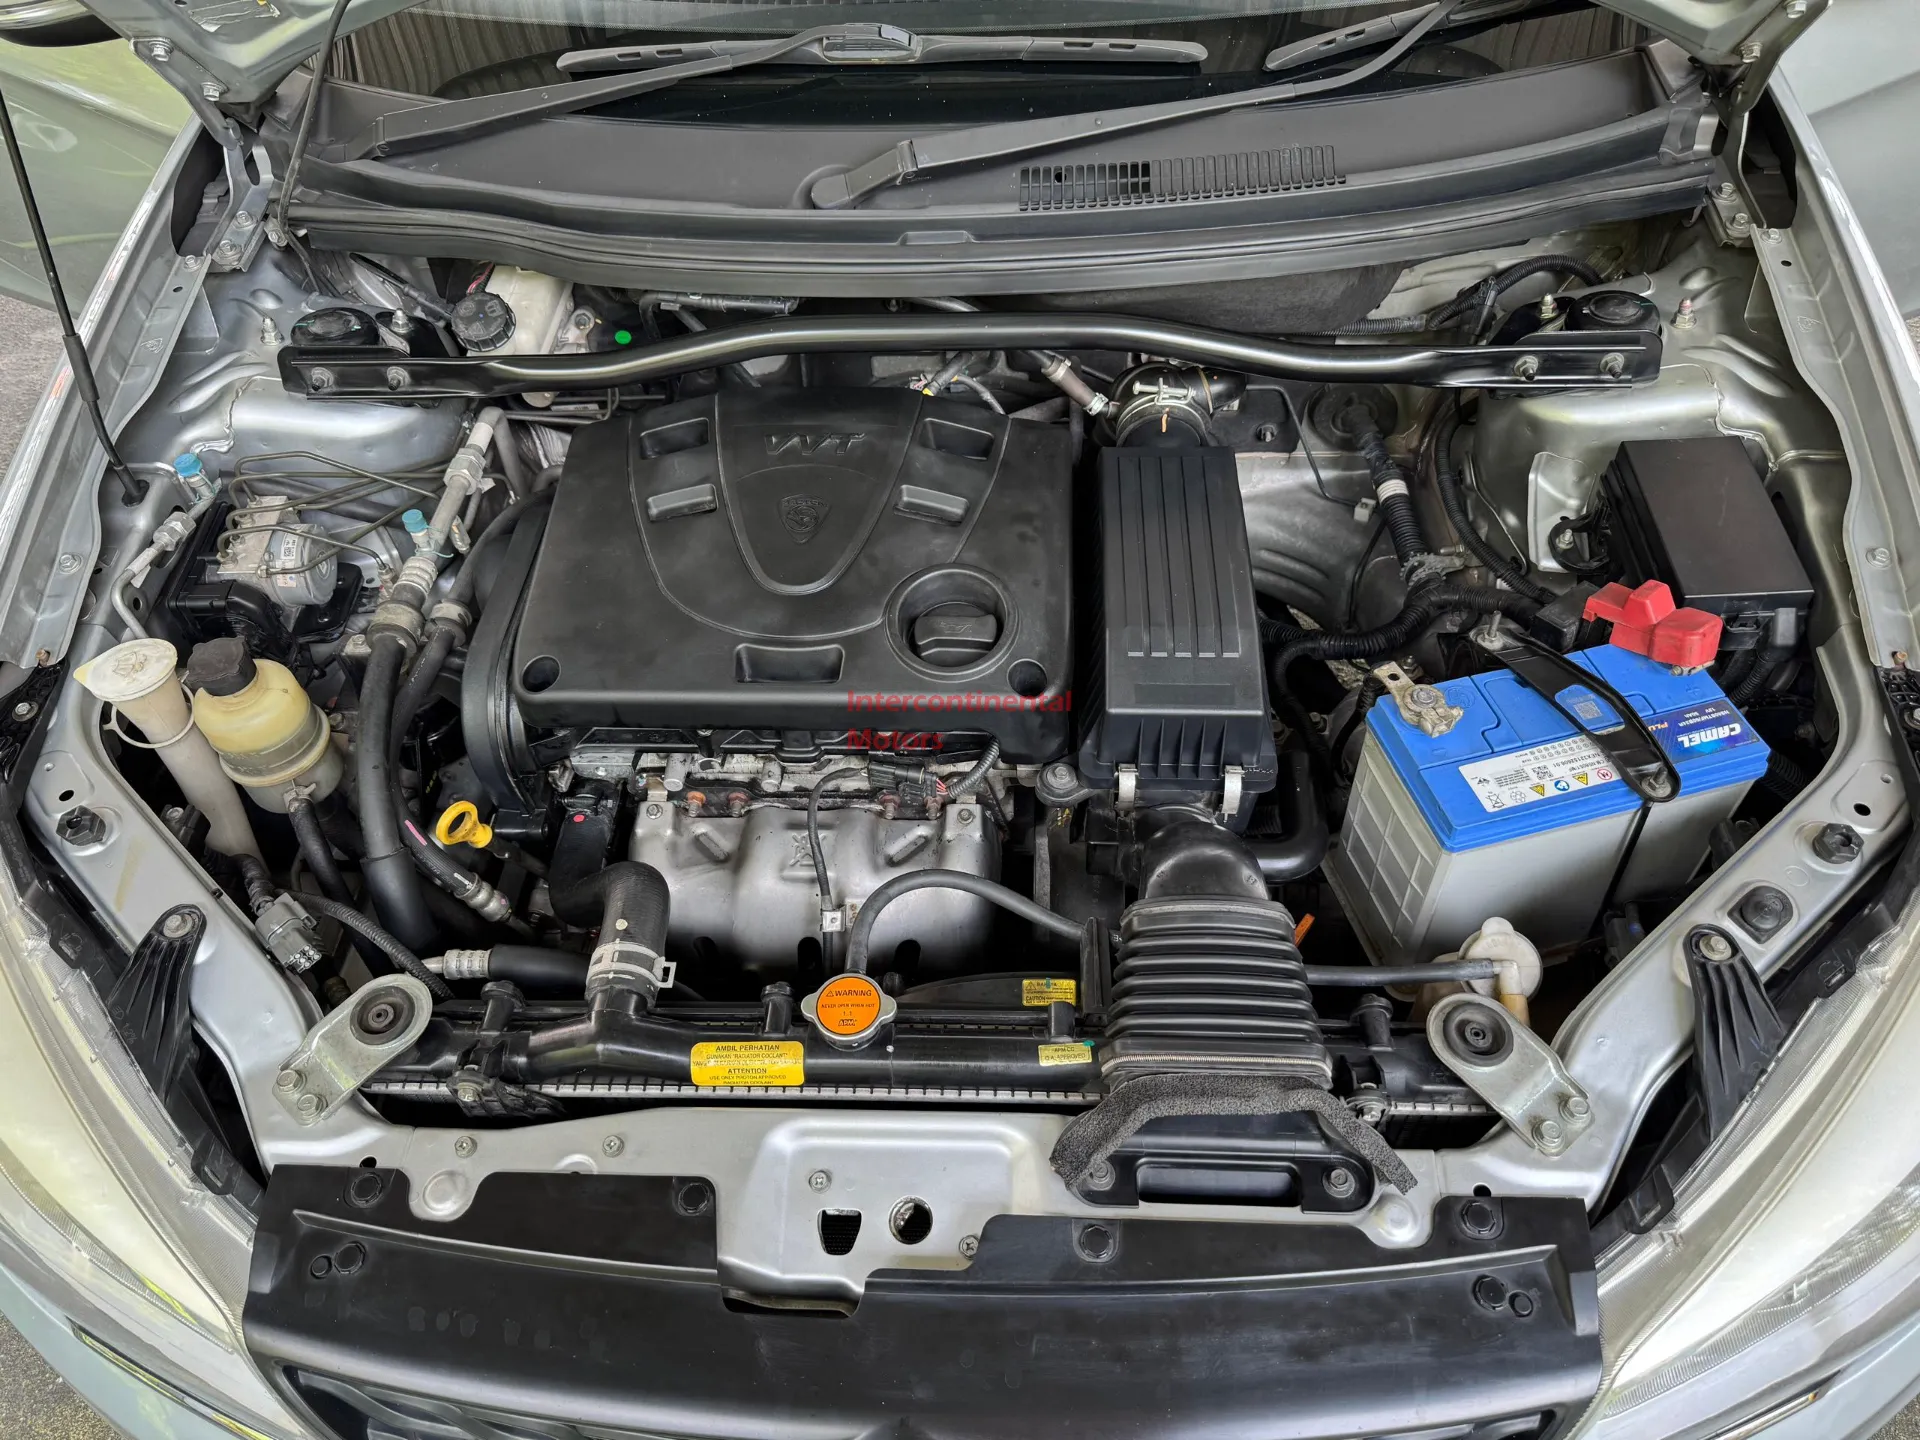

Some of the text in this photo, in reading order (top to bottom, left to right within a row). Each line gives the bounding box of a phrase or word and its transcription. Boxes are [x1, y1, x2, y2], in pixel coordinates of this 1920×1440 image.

[764, 432, 867, 456] VVT
[1648, 721, 1668, 731] PLU
[1677, 723, 1742, 748] CAMEL
[835, 989, 872, 997] WARNING
